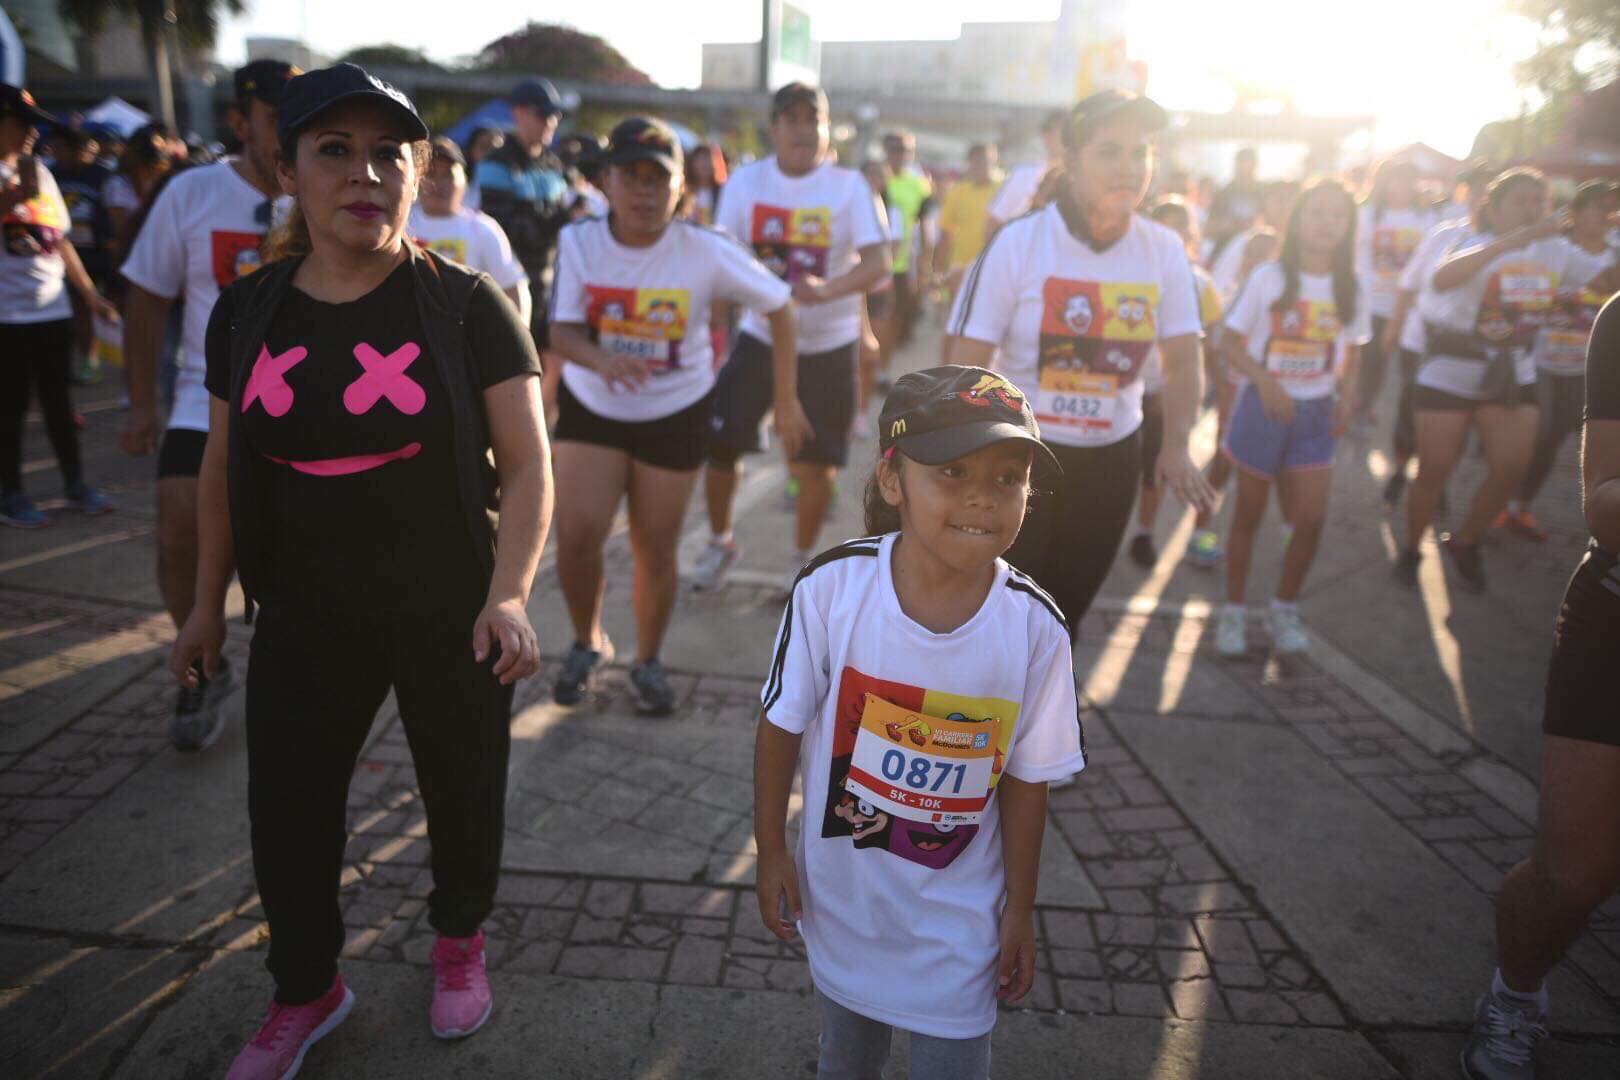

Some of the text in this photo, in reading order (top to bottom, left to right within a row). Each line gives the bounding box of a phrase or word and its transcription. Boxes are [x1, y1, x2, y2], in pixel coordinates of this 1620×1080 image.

[1052, 396, 1102, 417] 0432
[932, 733, 973, 746] FAMILIAR
[881, 749, 967, 794] 0871
[889, 789, 907, 803] 5K
[919, 797, 942, 809] 10K
